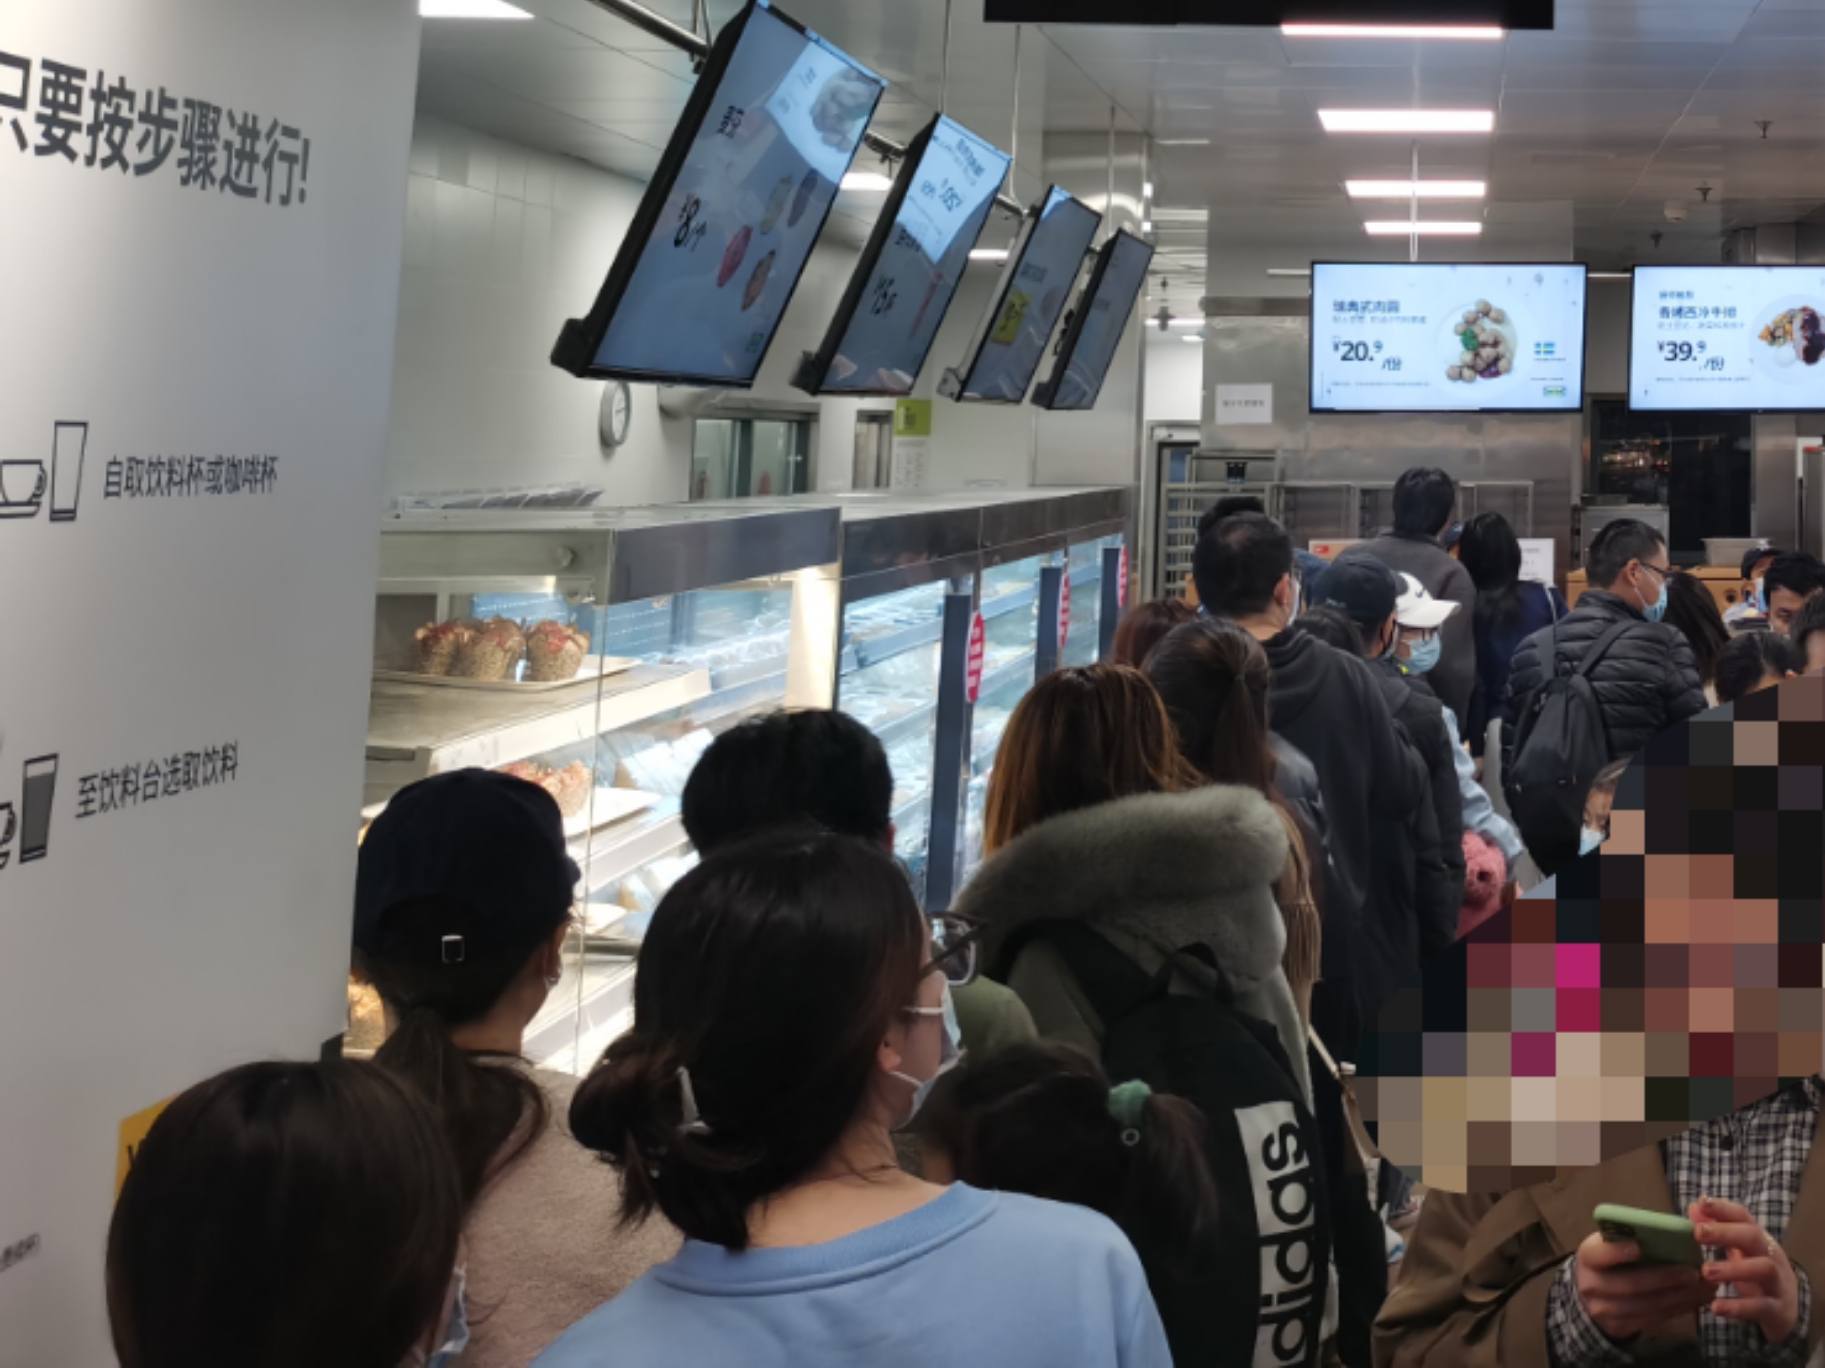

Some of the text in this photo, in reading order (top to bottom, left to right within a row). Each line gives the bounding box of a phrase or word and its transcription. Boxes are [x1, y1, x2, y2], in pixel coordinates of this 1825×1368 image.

[103, 454, 279, 500] 自取饮料杯或咖啡杯
[75, 740, 239, 820] 至饮料台选取饮料
